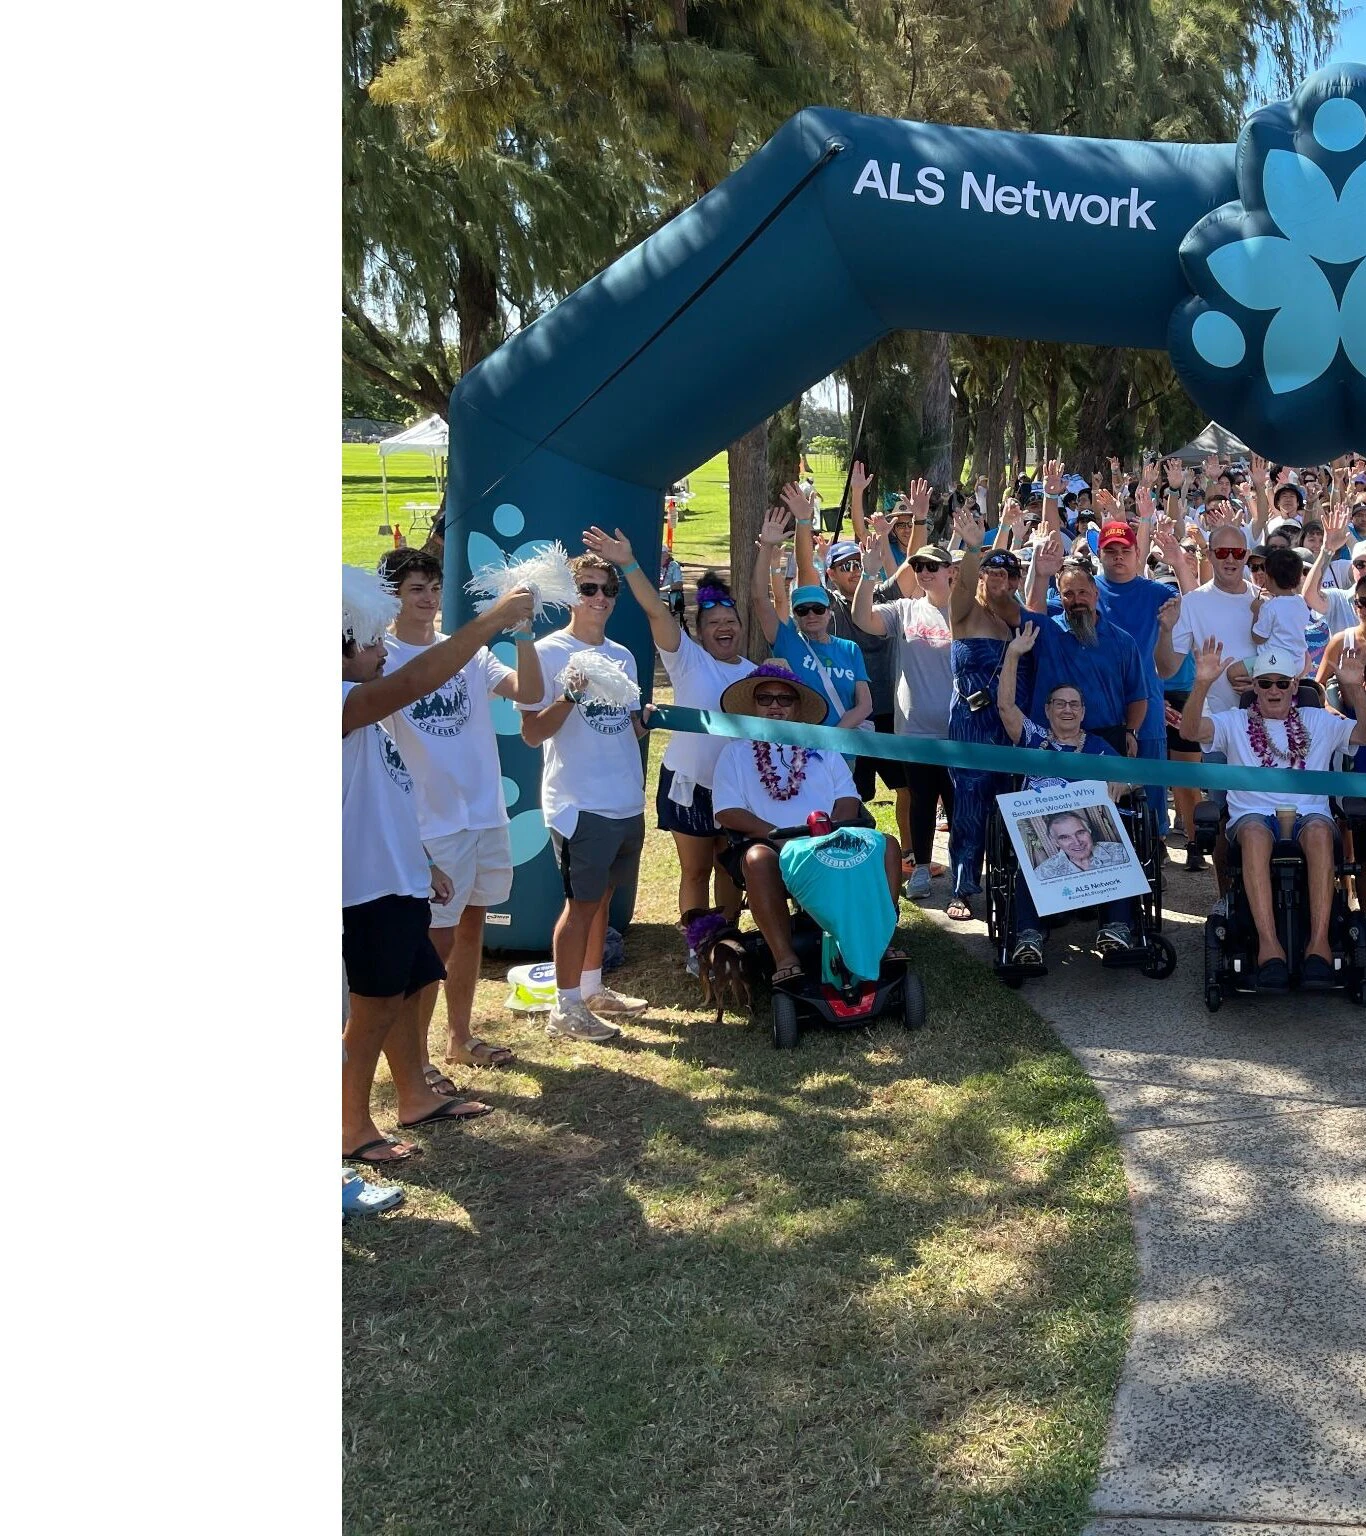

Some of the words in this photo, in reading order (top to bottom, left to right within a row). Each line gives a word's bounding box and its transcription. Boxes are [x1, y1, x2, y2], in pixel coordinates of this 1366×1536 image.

[852, 159, 945, 206] ALS
[960, 171, 1157, 231] Network
[1013, 798, 1032, 808] Our
[1034, 793, 1072, 805] Reason
[1072, 787, 1096, 798] Why
[1012, 807, 1045, 818] Because
[1046, 802, 1073, 813] Woody
[816, 851, 868, 868] CELEBRATION
[1075, 884, 1090, 893] ALS
[1090, 878, 1122, 890] Network
